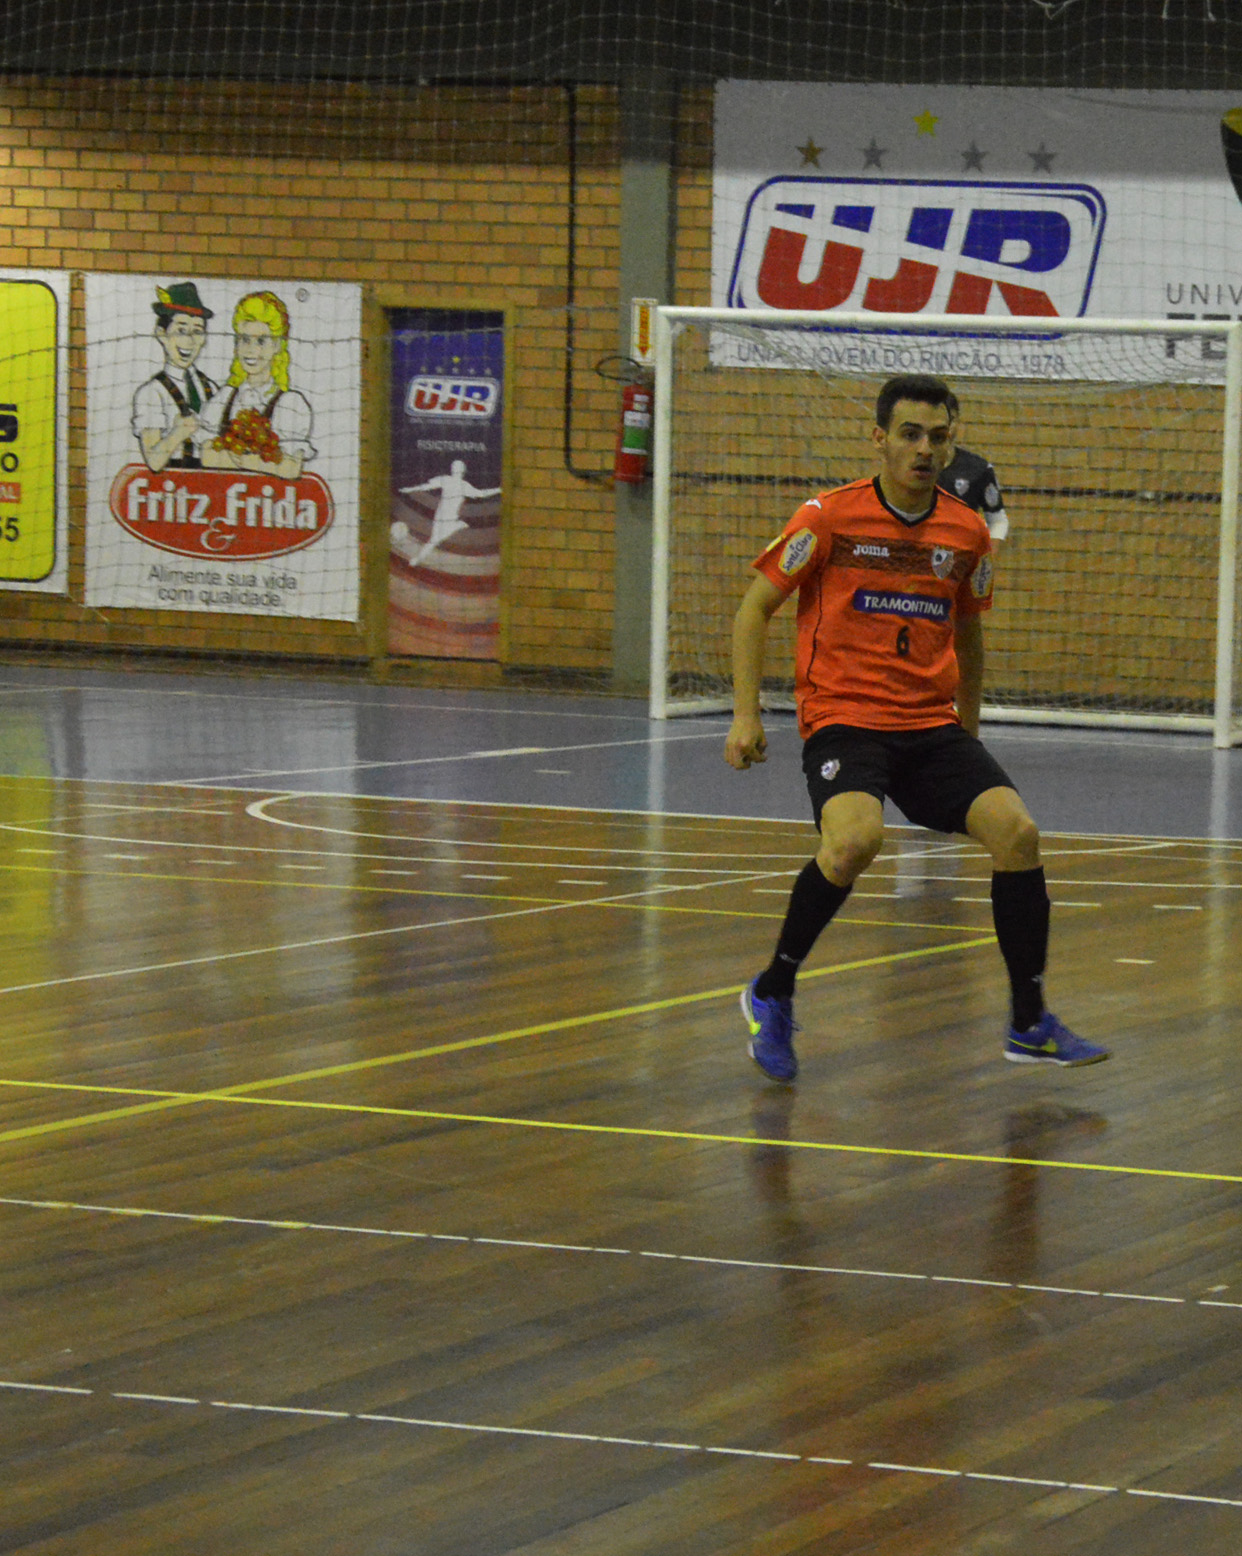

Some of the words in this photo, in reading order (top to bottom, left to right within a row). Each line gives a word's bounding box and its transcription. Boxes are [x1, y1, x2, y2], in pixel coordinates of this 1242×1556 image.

[756, 202, 1072, 317] UJR
[884, 348, 915, 368] DO
[414, 382, 490, 412] UJR
[148, 564, 222, 586] Alimente
[227, 571, 257, 588] sua
[263, 571, 298, 590] vida
[158, 586, 194, 601] com
[864, 595, 945, 616] TRAMONTINA
[896, 625, 910, 656] 6
